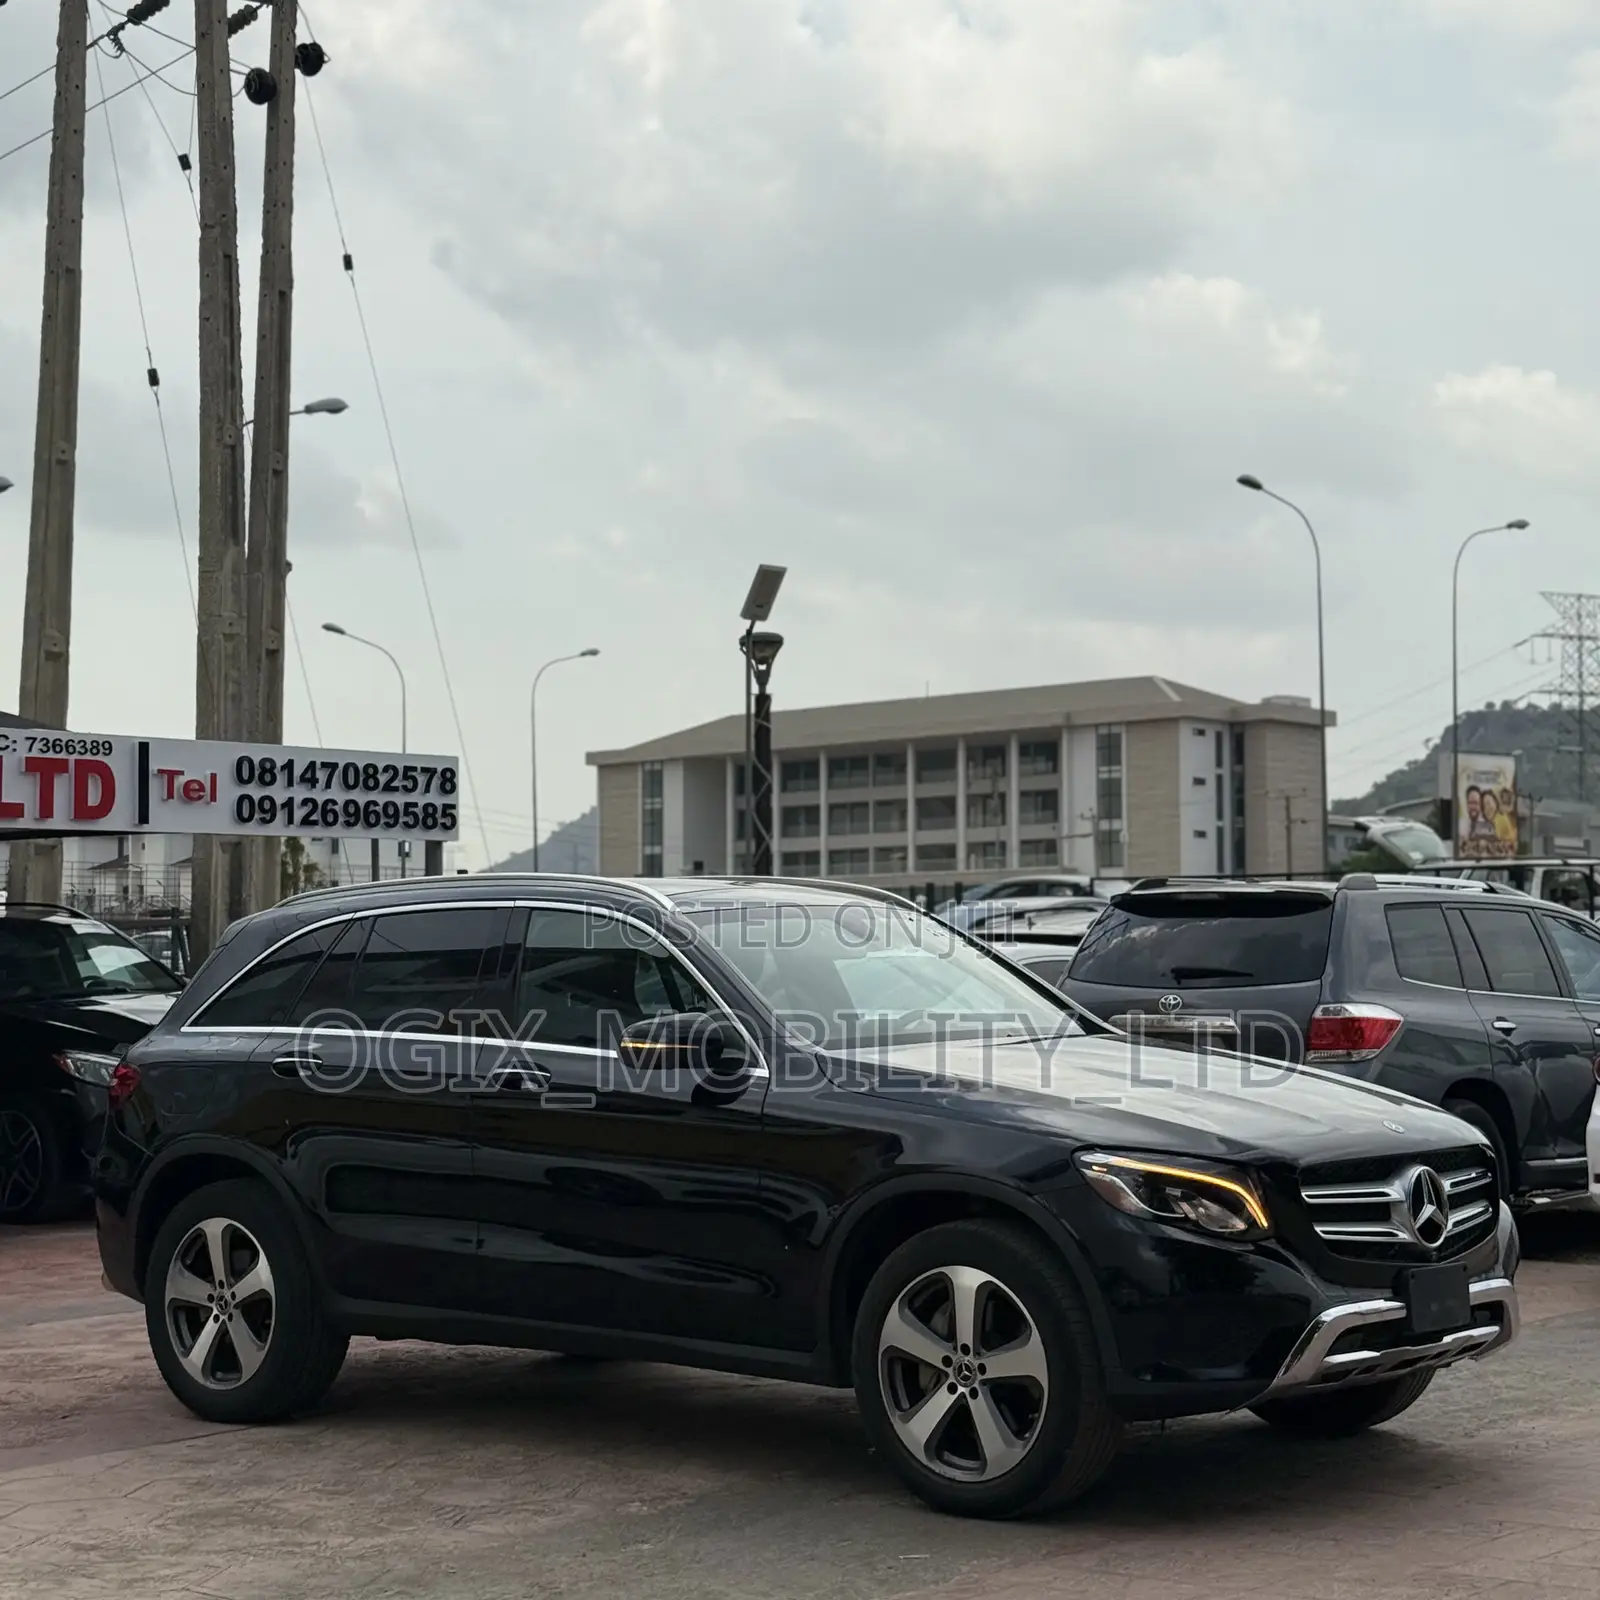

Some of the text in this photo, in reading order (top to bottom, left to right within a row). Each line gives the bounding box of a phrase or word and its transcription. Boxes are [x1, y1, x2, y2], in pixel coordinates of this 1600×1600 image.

[24, 737, 113, 756] 7366389
[0, 755, 116, 820] LTD
[156, 768, 218, 803] Tel
[235, 755, 457, 795] 08147082578
[235, 793, 457, 830] 09126969585
